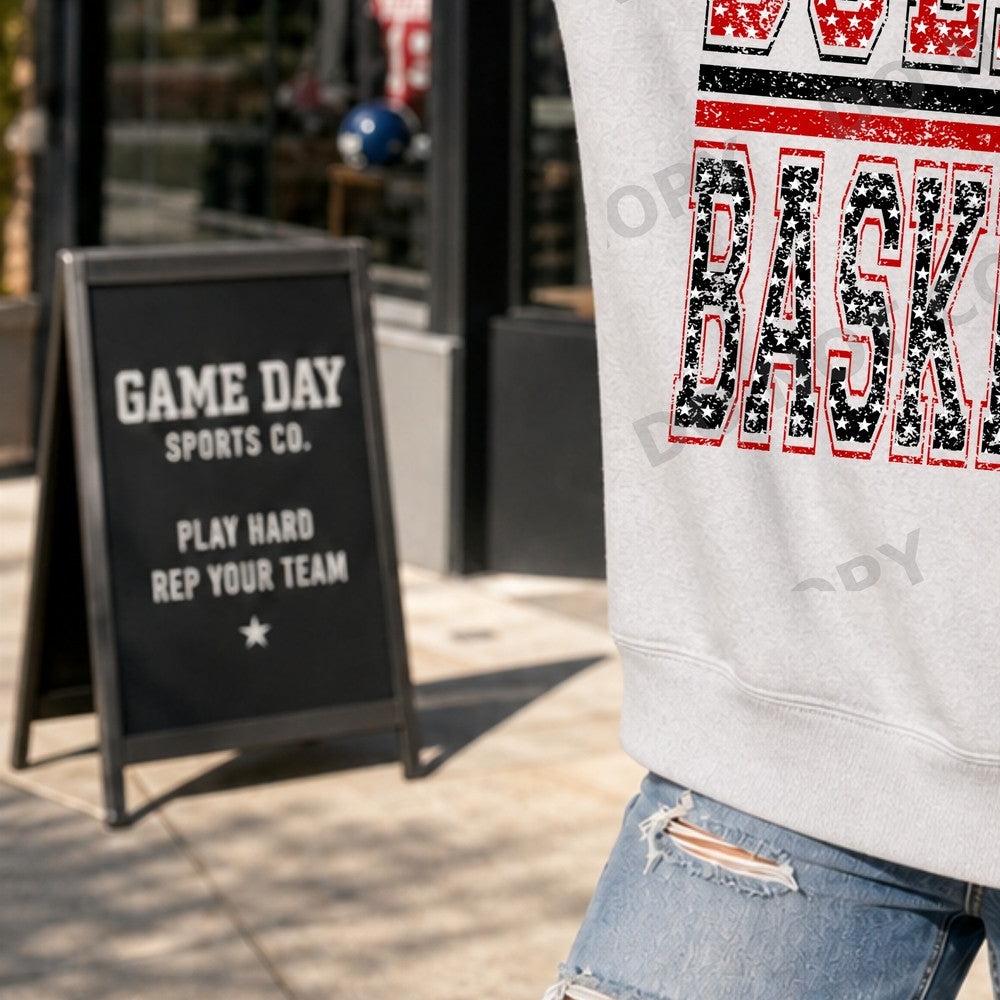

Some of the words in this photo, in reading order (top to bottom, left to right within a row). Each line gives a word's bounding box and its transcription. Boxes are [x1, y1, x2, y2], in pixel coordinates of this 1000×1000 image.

[114, 361, 249, 424] GAME
[259, 356, 345, 412] DAY
[165, 427, 262, 462] SPORTS
[270, 422, 311, 454] CO.
[177, 515, 238, 553] PLAY
[248, 508, 314, 545] HARD
[151, 567, 200, 603] REP
[207, 559, 274, 597] YOUR
[281, 550, 348, 588] TEAM
